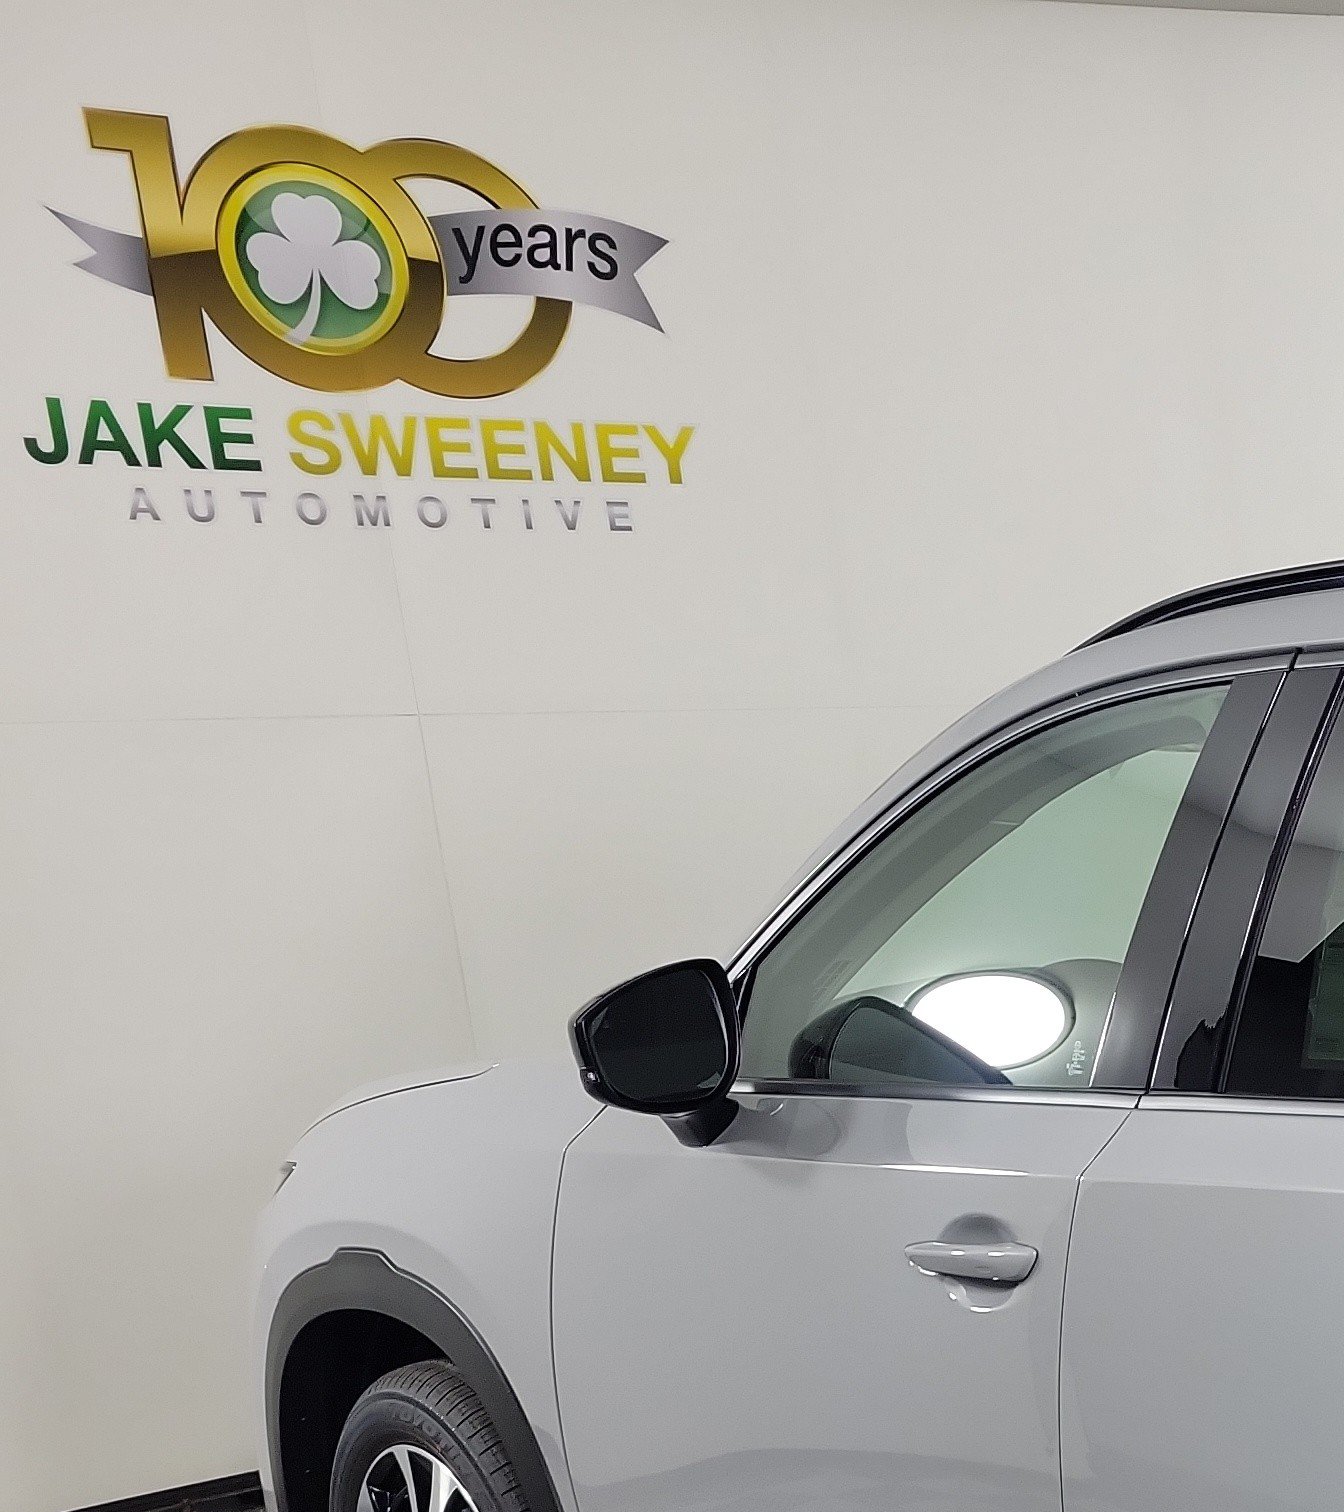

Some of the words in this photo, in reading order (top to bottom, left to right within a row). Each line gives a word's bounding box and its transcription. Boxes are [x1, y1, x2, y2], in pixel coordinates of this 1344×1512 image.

[83, 107, 573, 399] 100
[452, 221, 619, 284] years
[22, 396, 263, 472] JAKE
[286, 408, 696, 485] SWEENEY
[128, 486, 634, 532] AUTOMOTIVE
